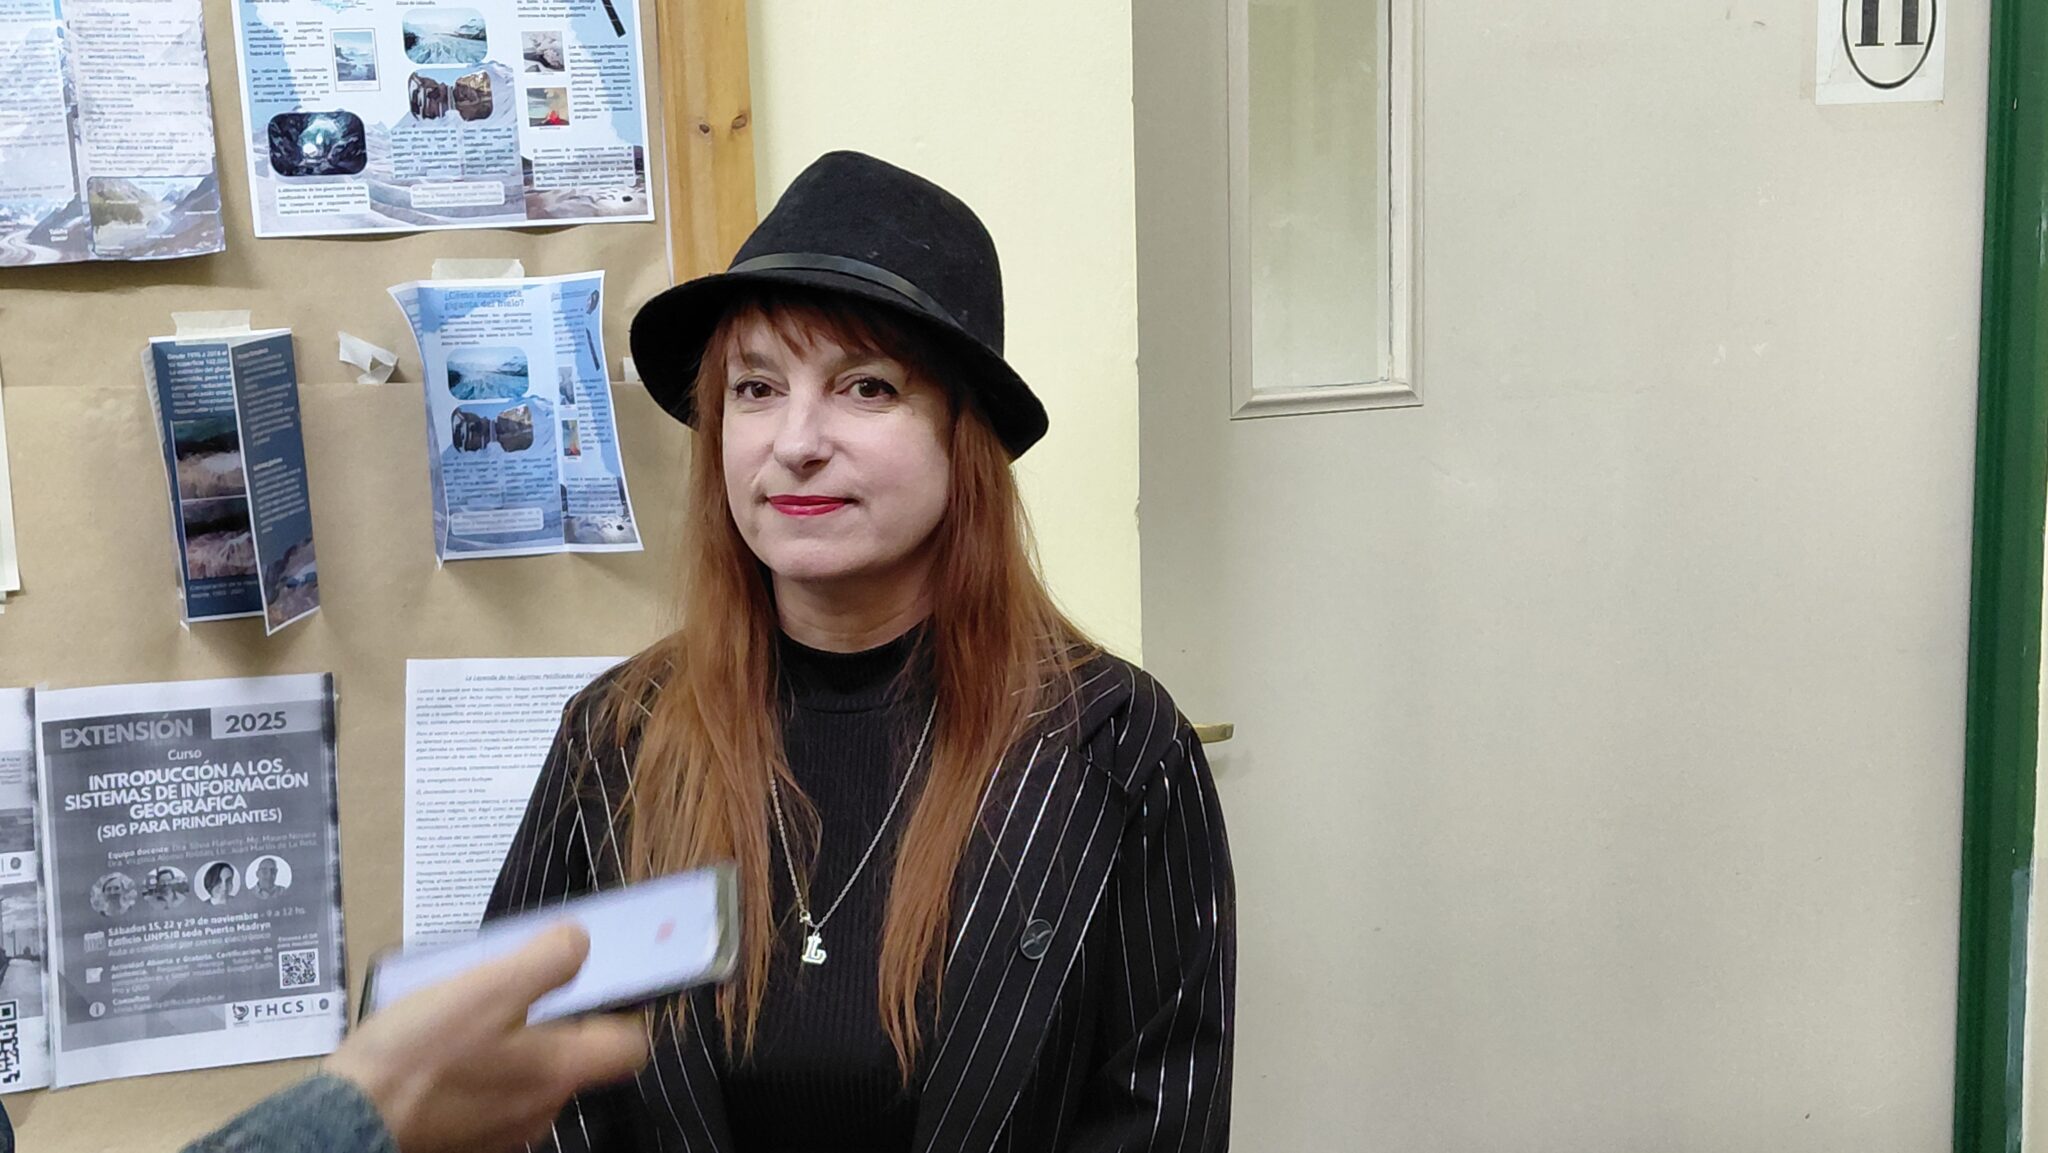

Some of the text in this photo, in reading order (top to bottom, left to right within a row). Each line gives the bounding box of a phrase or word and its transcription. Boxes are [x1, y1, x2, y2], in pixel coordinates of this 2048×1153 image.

[60, 714, 194, 749] EXTENSIÓN
[225, 711, 287, 734] 2025
[168, 749, 202, 761] Curso
[89, 758, 283, 791] INTRODUCCIÓN A LOS
[65, 768, 309, 811] SISTEMAS DE INFORMACIÓN
[130, 794, 247, 820] GEOGRAFICA
[97, 807, 282, 843] (SIG PARA PRINCIPIANTES)
[108, 924, 146, 936] Sábados
[163, 920, 174, 929] 22
[176, 921, 182, 929] y
[197, 916, 209, 926] de
[210, 912, 259, 924] noviembre
[108, 935, 142, 947] Edificio
[182, 928, 203, 938] sede
[204, 925, 235, 935] Puerto
[237, 921, 271, 932] Madryn
[254, 1000, 304, 1017] FHCS
